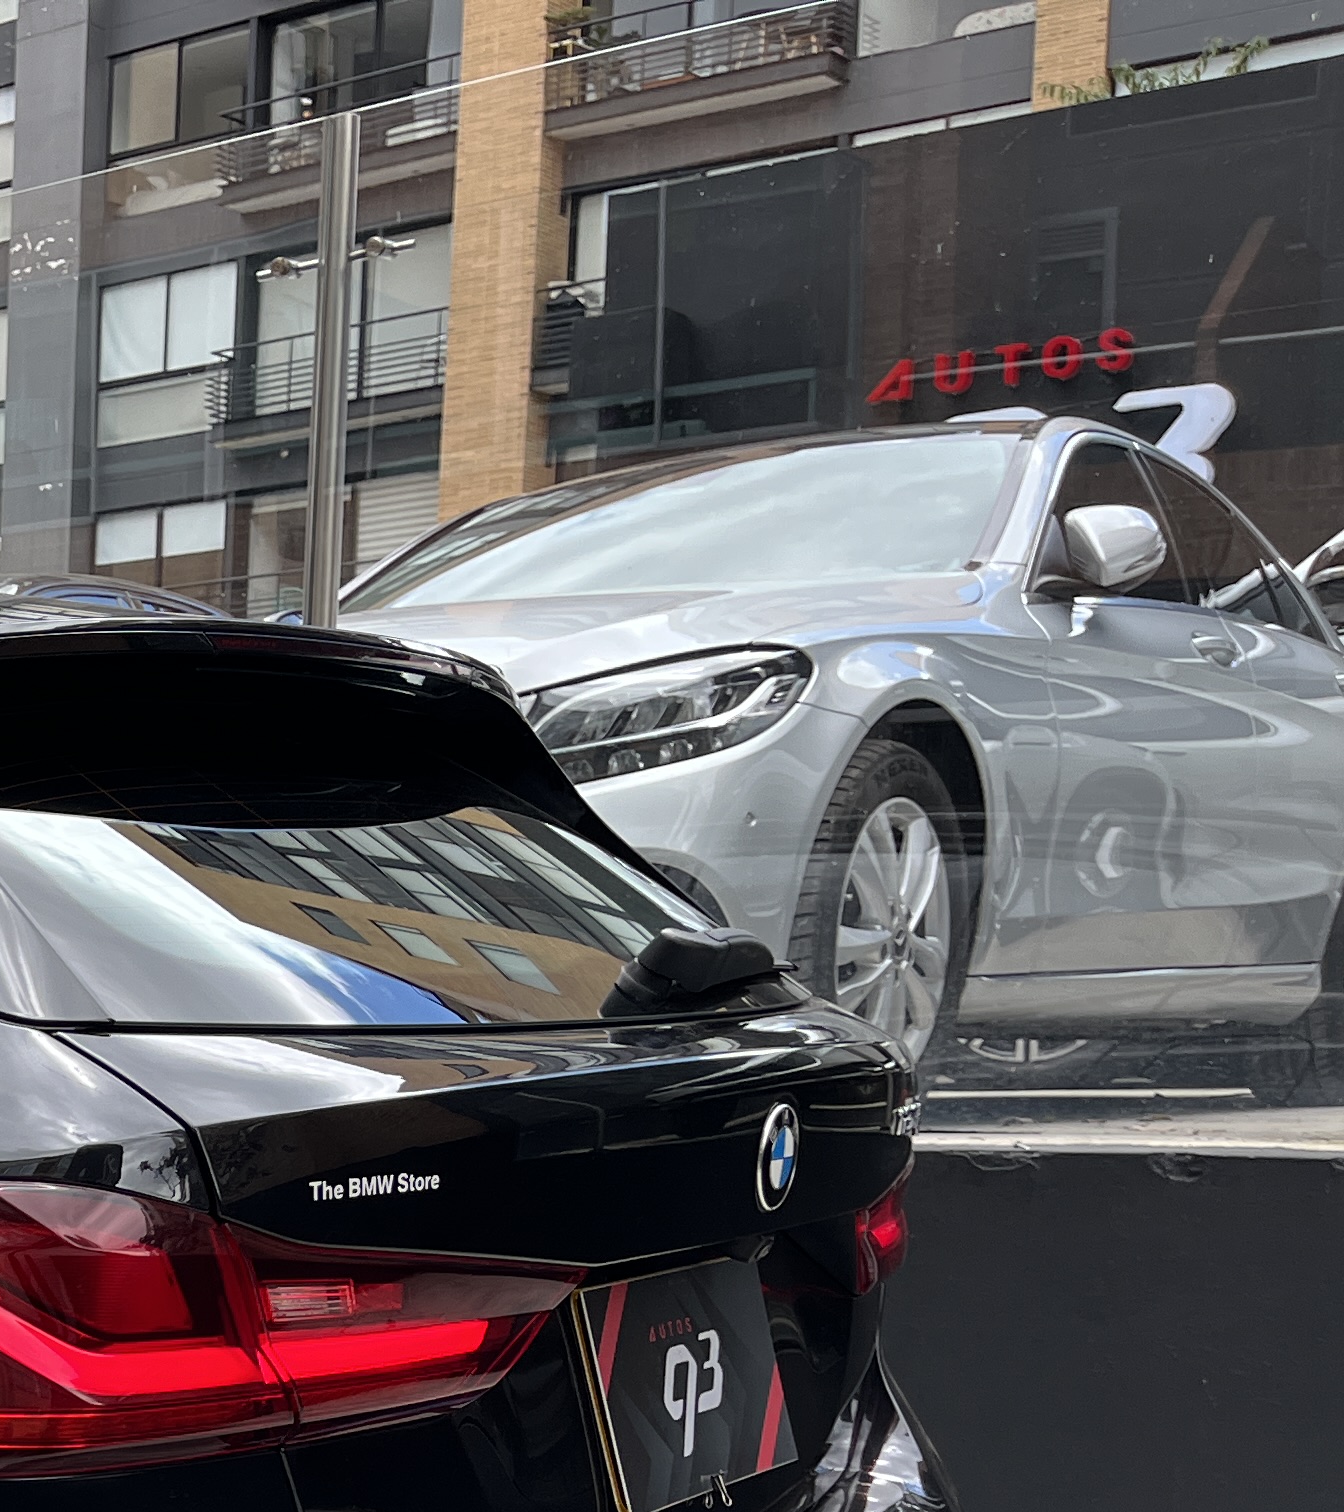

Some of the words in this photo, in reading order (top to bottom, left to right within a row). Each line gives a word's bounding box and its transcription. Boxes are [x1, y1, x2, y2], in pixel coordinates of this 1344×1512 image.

[867, 328, 1135, 404] AUTOS
[309, 1180, 344, 1201] The
[348, 1174, 394, 1198] BMW
[397, 1172, 440, 1193] Store
[649, 1317, 692, 1343] AUTOS
[663, 1329, 724, 1458] 93
